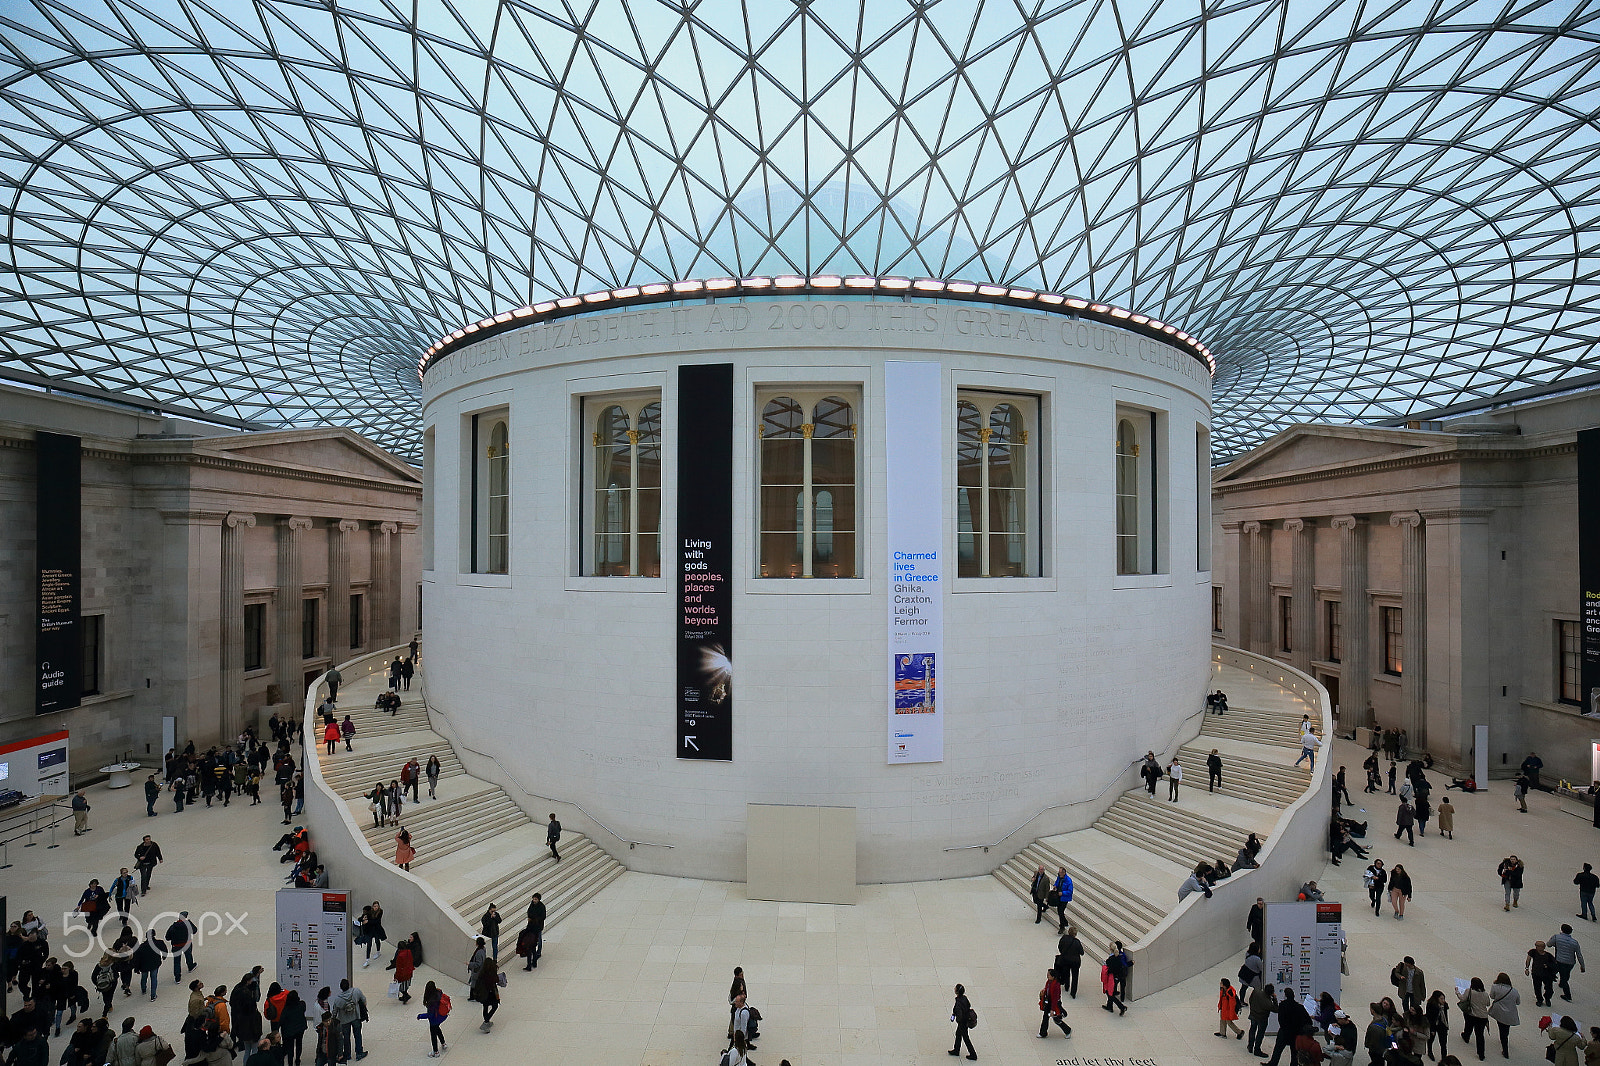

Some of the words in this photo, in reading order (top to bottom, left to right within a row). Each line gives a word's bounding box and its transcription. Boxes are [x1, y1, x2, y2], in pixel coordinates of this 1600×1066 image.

[460, 335, 512, 374] QUEEN
[518, 311, 658, 355] ELIZABETH
[671, 310, 693, 335] II
[704, 305, 751, 333] AD
[767, 304, 851, 331] 2000
[864, 305, 938, 333] THIS
[954, 309, 1049, 343] GREAT
[1060, 321, 1132, 358] COURT
[685, 539, 712, 549] Living
[685, 550, 704, 559] with
[894, 551, 937, 560] Charmed
[685, 561, 708, 571] gods
[894, 562, 915, 571] lives
[685, 572, 724, 582] peoples,
[894, 573, 902, 582] in
[904, 573, 939, 582] Greece
[685, 583, 715, 592] places
[894, 584, 924, 593] Ghika,
[685, 594, 702, 603] and
[894, 595, 933, 605] Craxton,
[685, 605, 716, 614] worlds
[894, 606, 920, 616] Leigh
[685, 616, 719, 626] beyond
[894, 617, 928, 626] Fermor
[42, 671, 65, 680] Audio
[42, 679, 64, 689] guide
[1056, 1057, 1080, 1066] and
[1083, 1057, 1101, 1066] let
[1104, 1057, 1124, 1066] thy
[1129, 1057, 1158, 1066] feet
